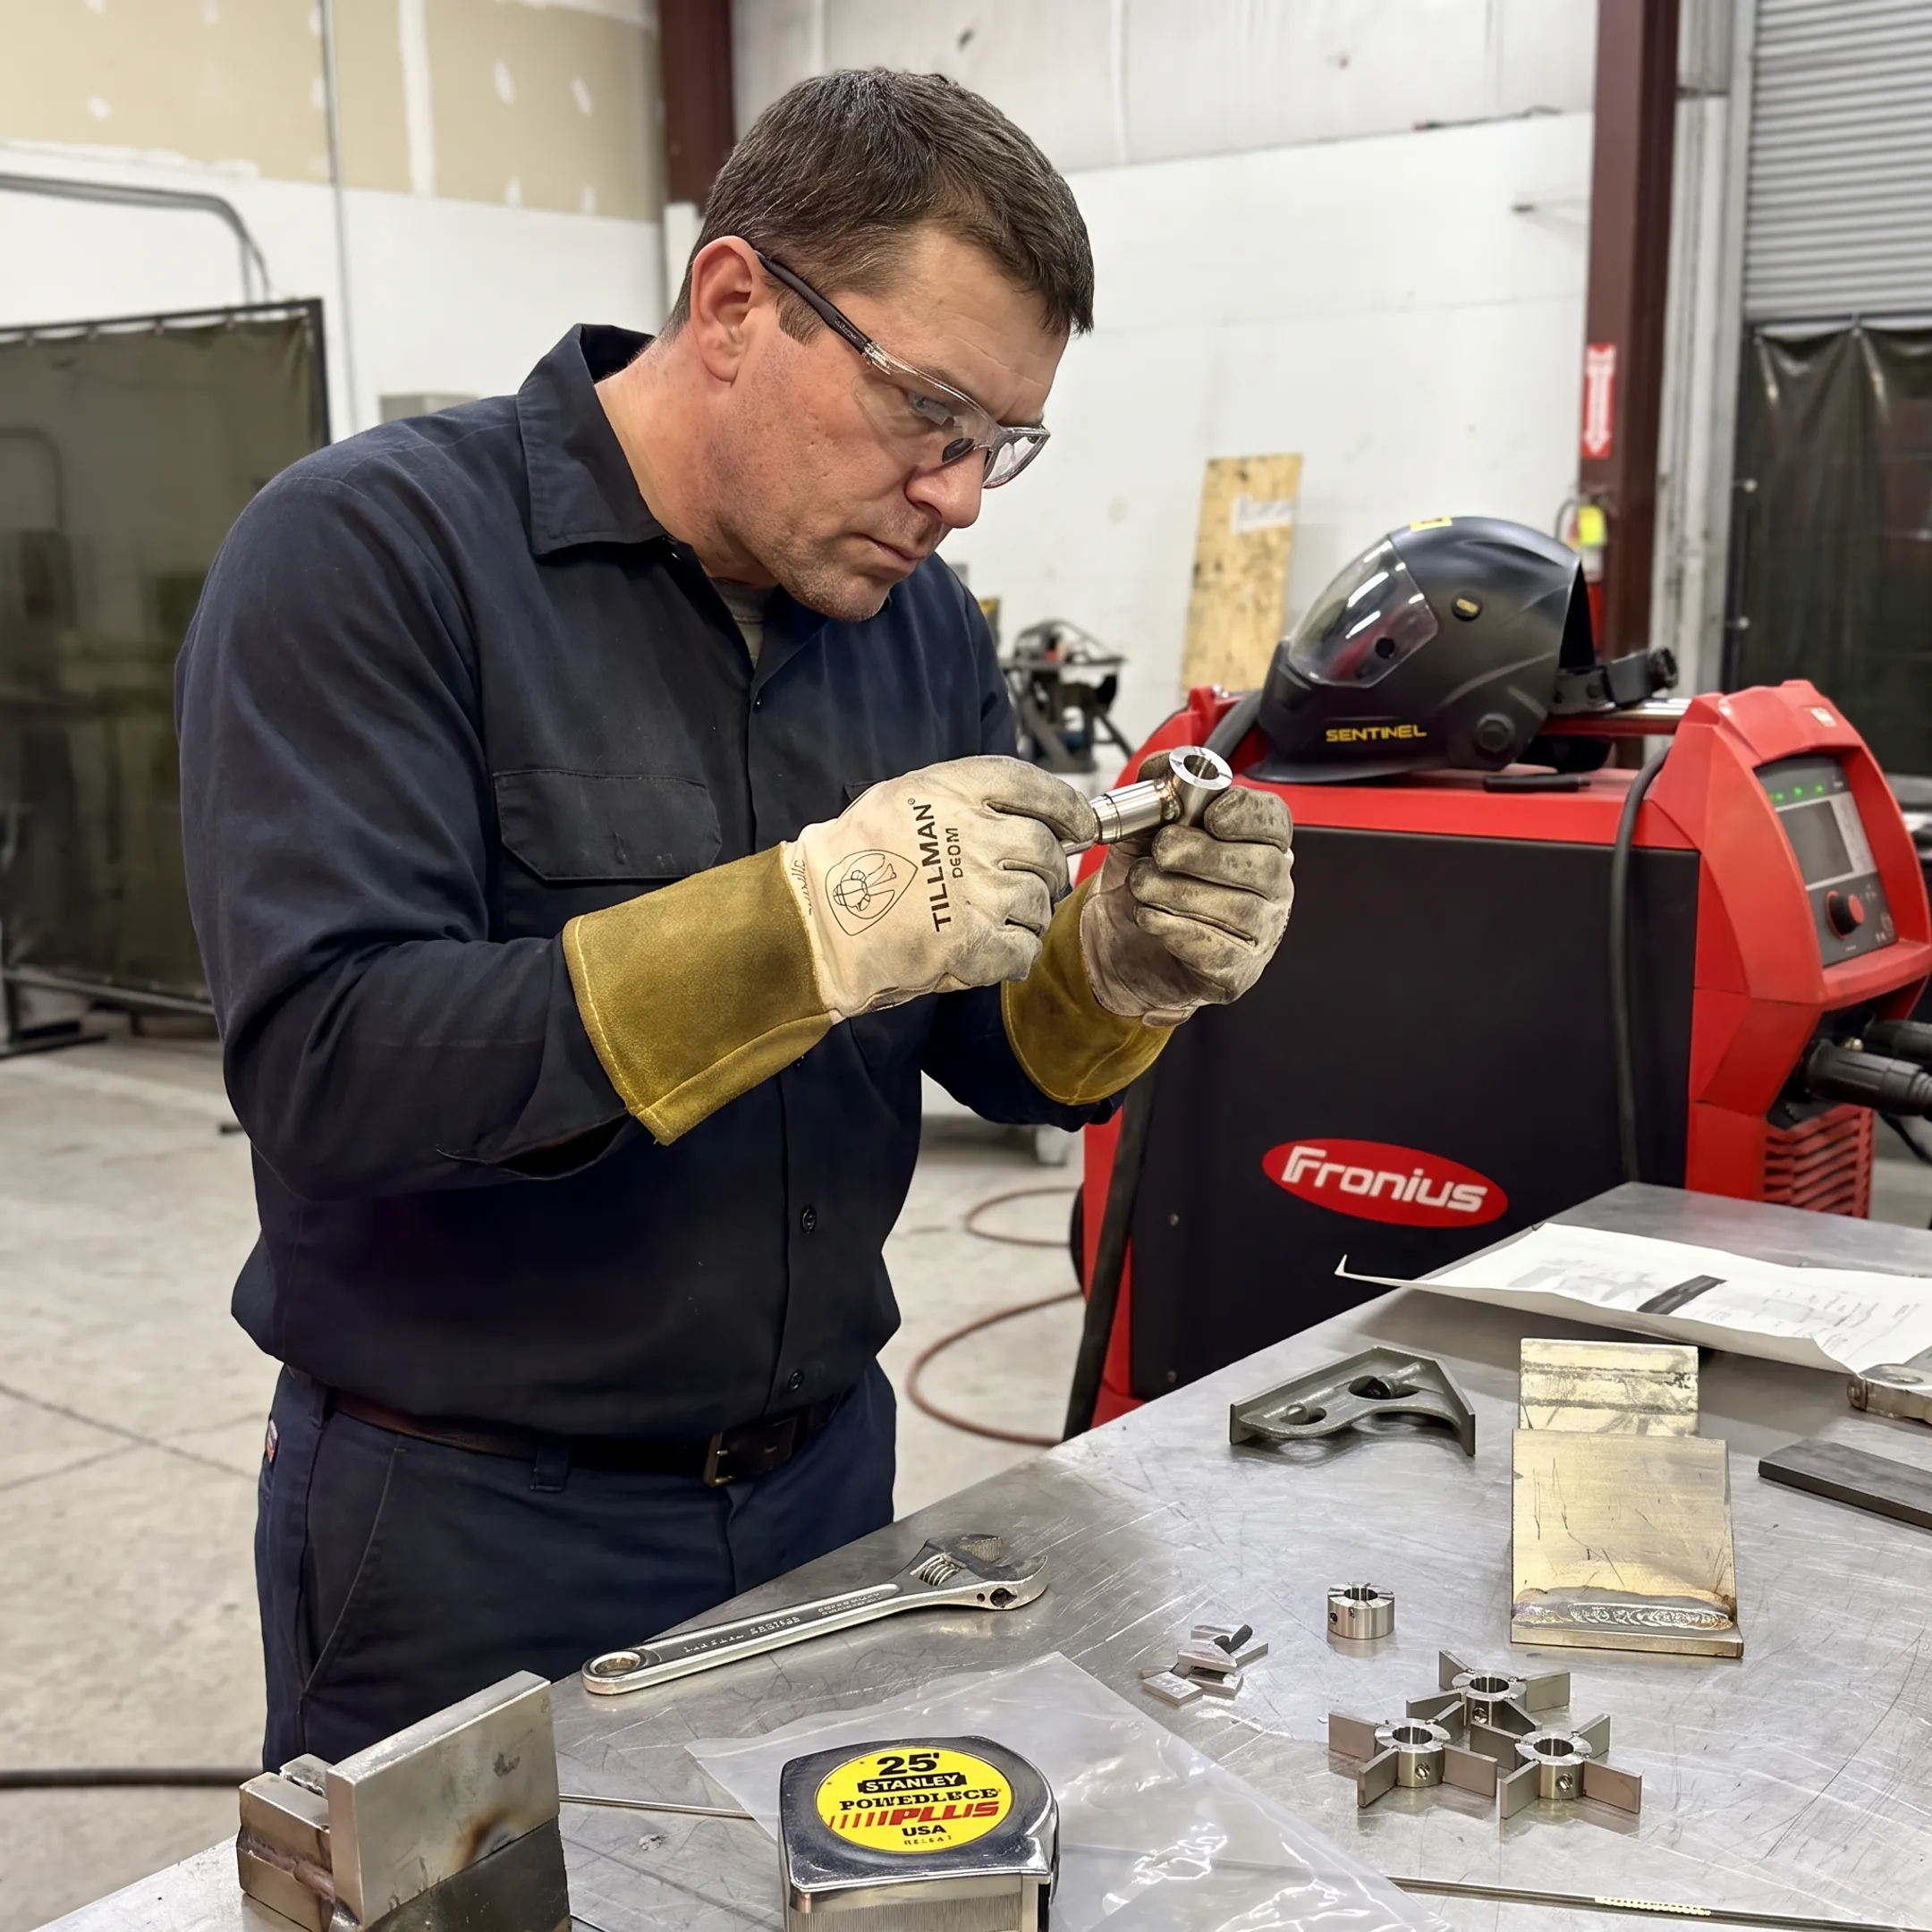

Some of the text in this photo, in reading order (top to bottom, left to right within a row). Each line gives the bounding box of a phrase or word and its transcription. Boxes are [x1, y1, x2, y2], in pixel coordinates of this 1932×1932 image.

[1326, 724, 1428, 742] SENTINEL
[913, 804, 952, 932] TILLMAN
[1281, 1145, 1488, 1213] Fronius
[865, 1775, 959, 1792] STANLEY
[902, 1825, 946, 1836] USA
